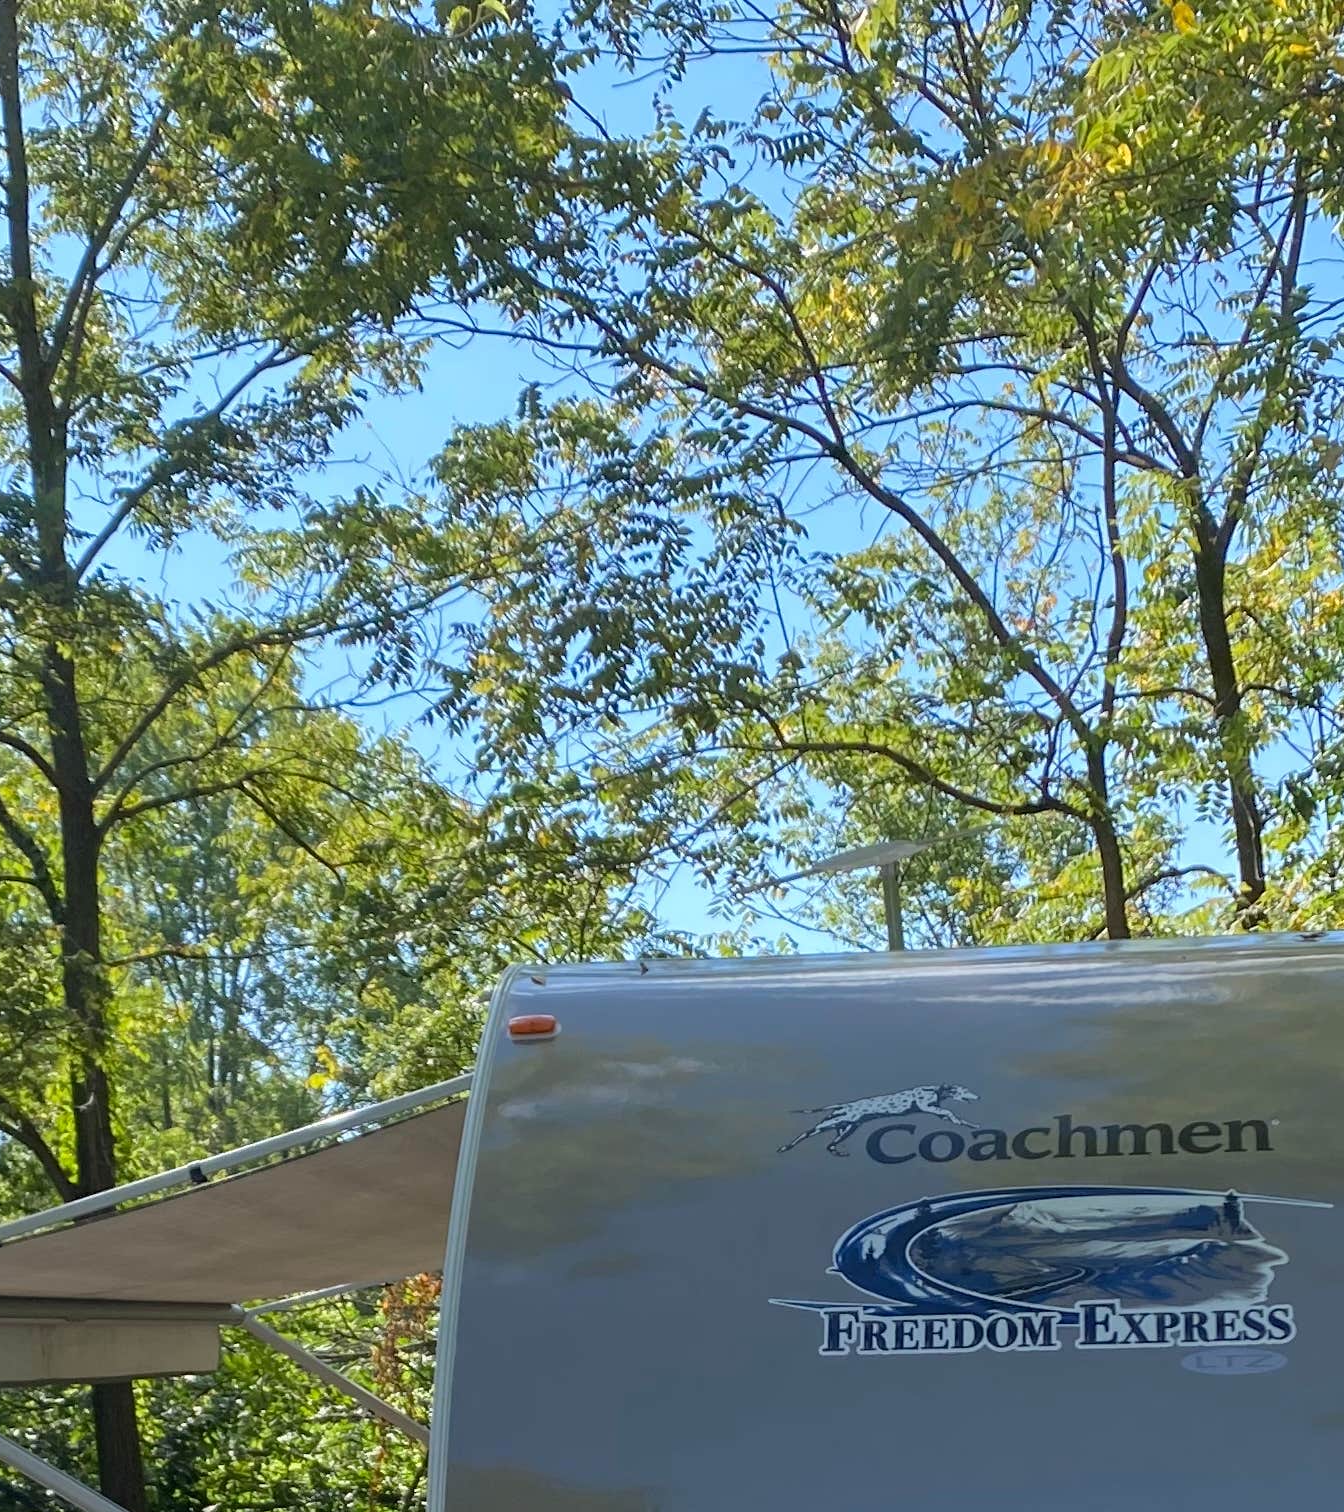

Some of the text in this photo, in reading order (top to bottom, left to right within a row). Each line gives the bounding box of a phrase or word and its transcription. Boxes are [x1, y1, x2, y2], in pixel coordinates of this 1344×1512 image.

[865, 1113, 1274, 1165] Coachmen
[821, 1302, 1293, 1353] FREEDOM EXPRESS
[1195, 1354, 1274, 1369] LTZ
